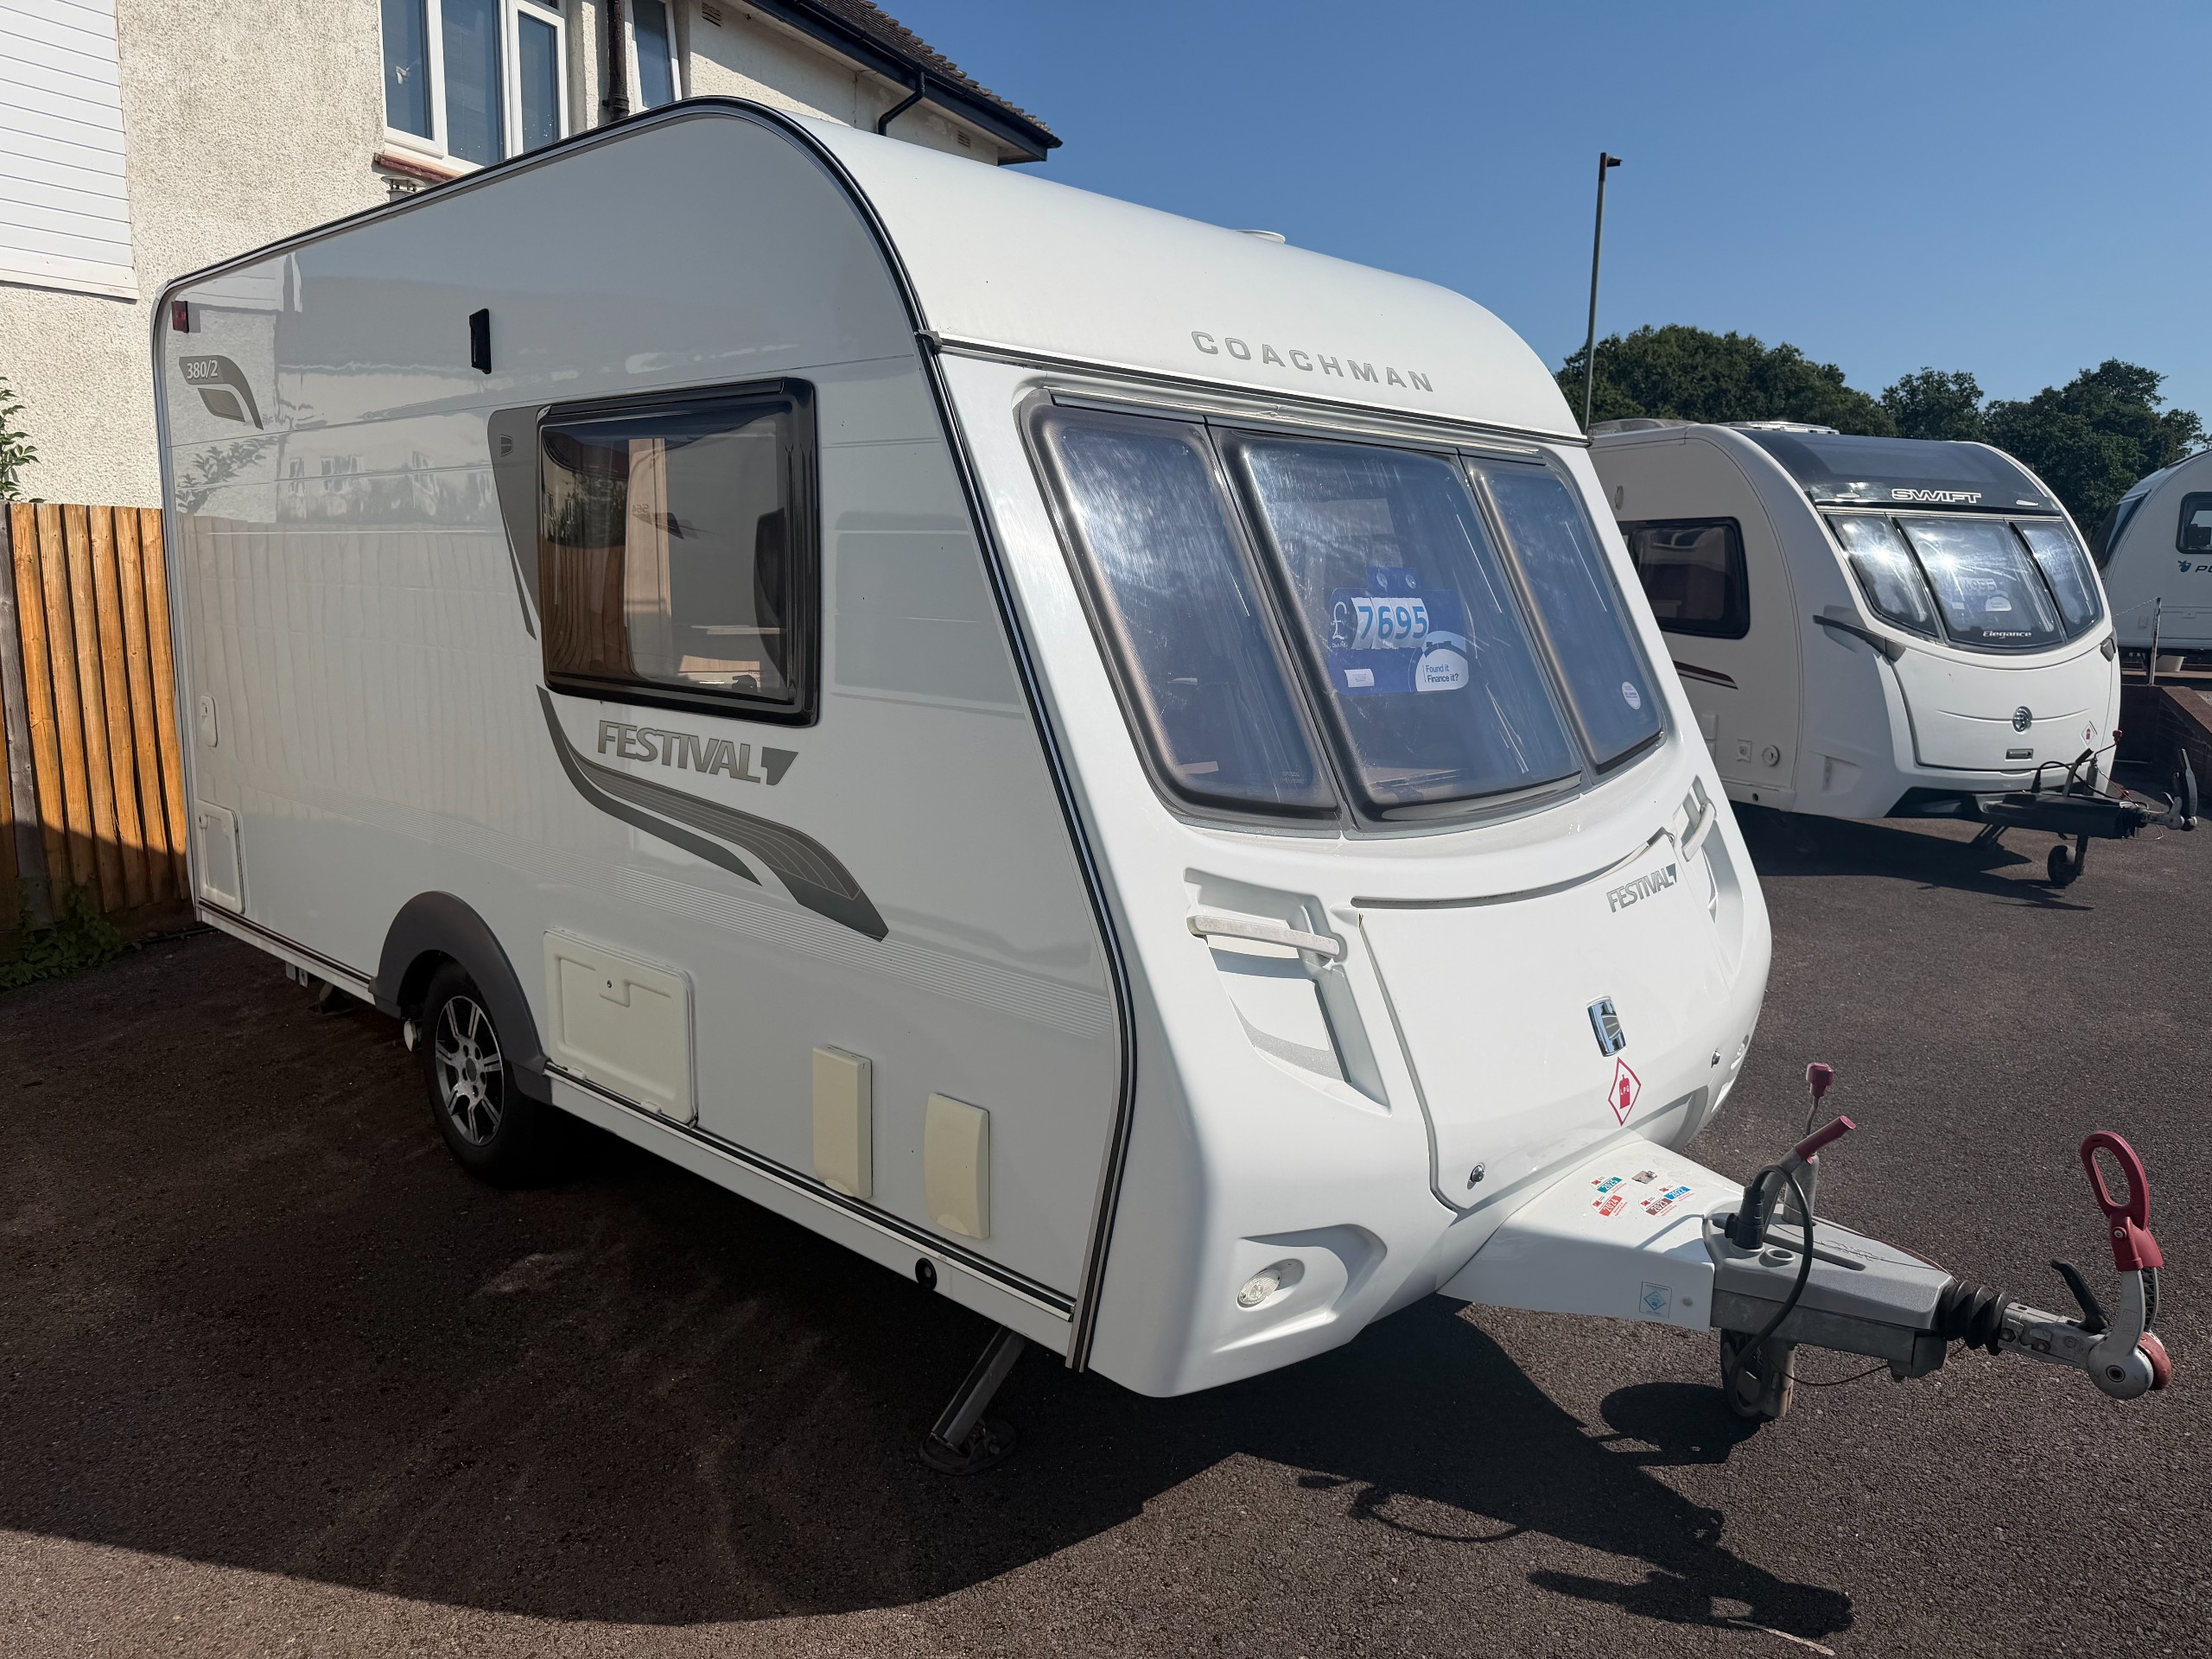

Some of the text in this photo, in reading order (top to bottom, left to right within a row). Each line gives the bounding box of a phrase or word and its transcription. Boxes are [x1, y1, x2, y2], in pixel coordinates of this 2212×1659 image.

[187, 359, 219, 379] 380/2
[1192, 331, 1433, 392] COACHMAN
[1891, 488, 1981, 504] SWIFT
[1982, 630, 2032, 639] Elegance
[1426, 664, 1444, 673] Found
[1427, 674, 1449, 683] Finance
[598, 720, 761, 784] FESTIVAL
[1606, 868, 1675, 912] FESTIVAL
[1604, 1198, 1619, 1212] 2024
